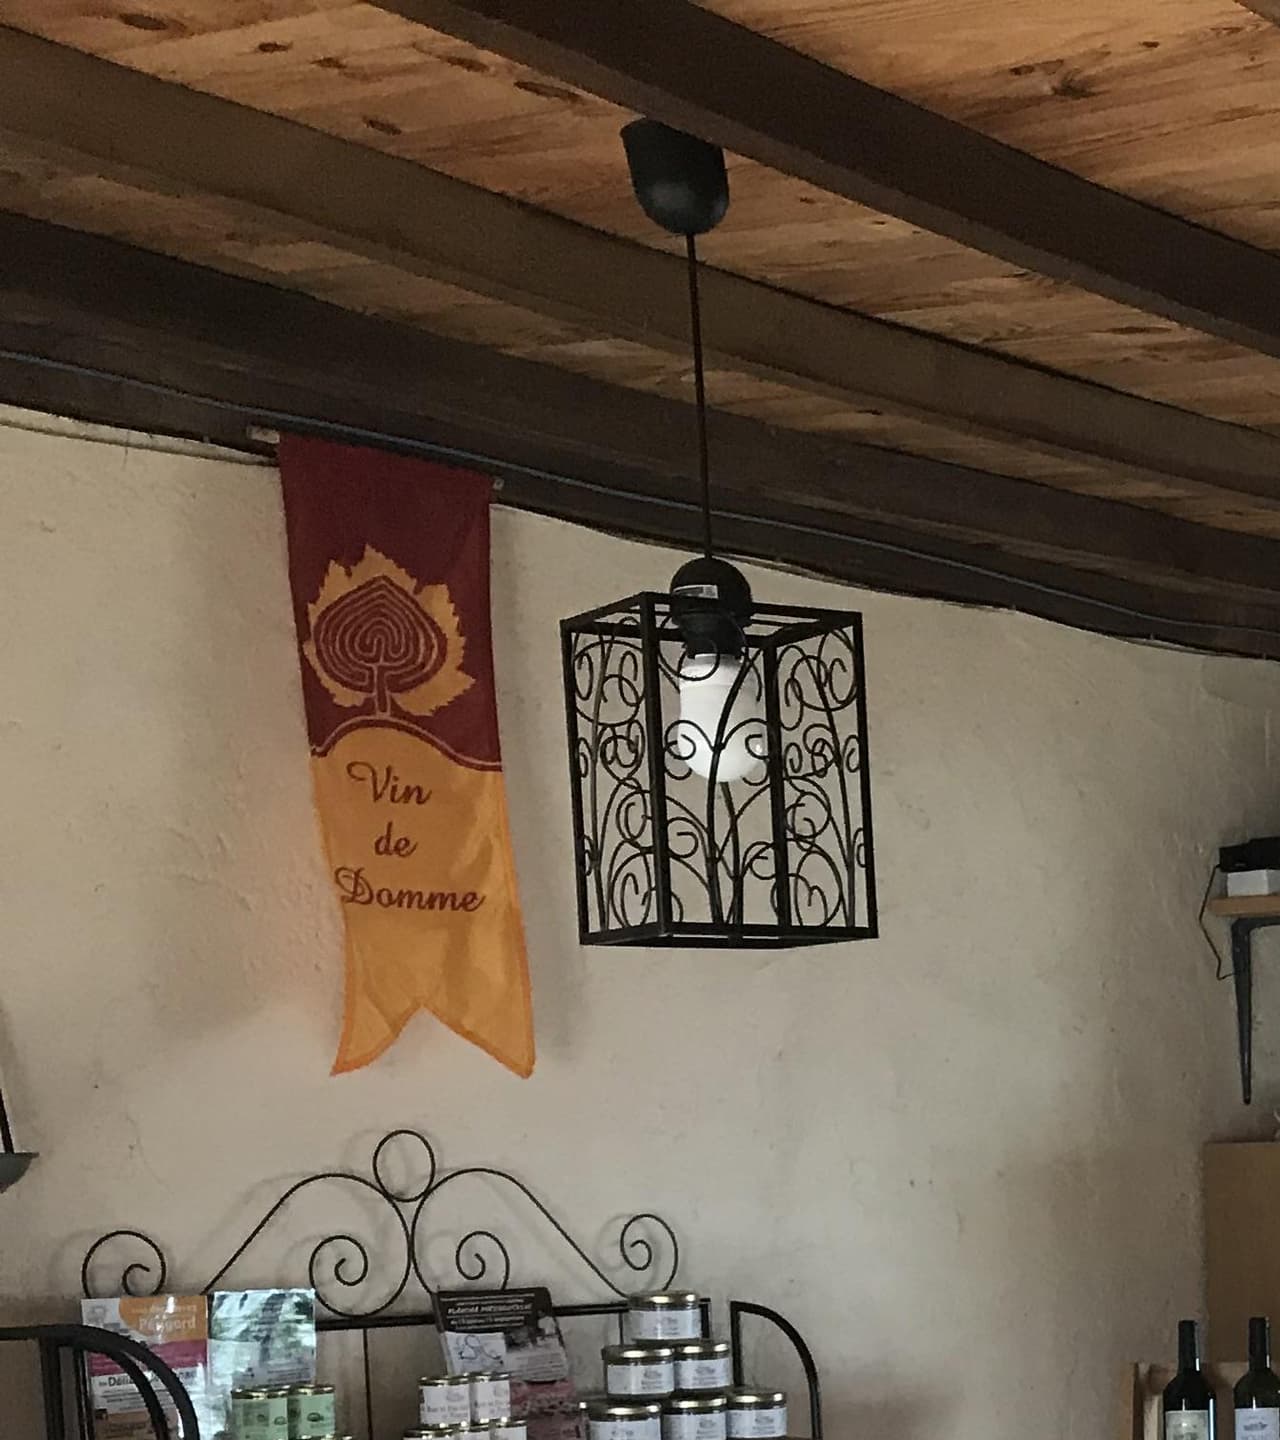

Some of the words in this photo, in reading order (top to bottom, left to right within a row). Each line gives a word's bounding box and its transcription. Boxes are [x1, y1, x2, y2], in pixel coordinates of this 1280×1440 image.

[346, 761, 433, 805] Vin
[374, 821, 419, 858] de
[334, 866, 487, 913] Domme
